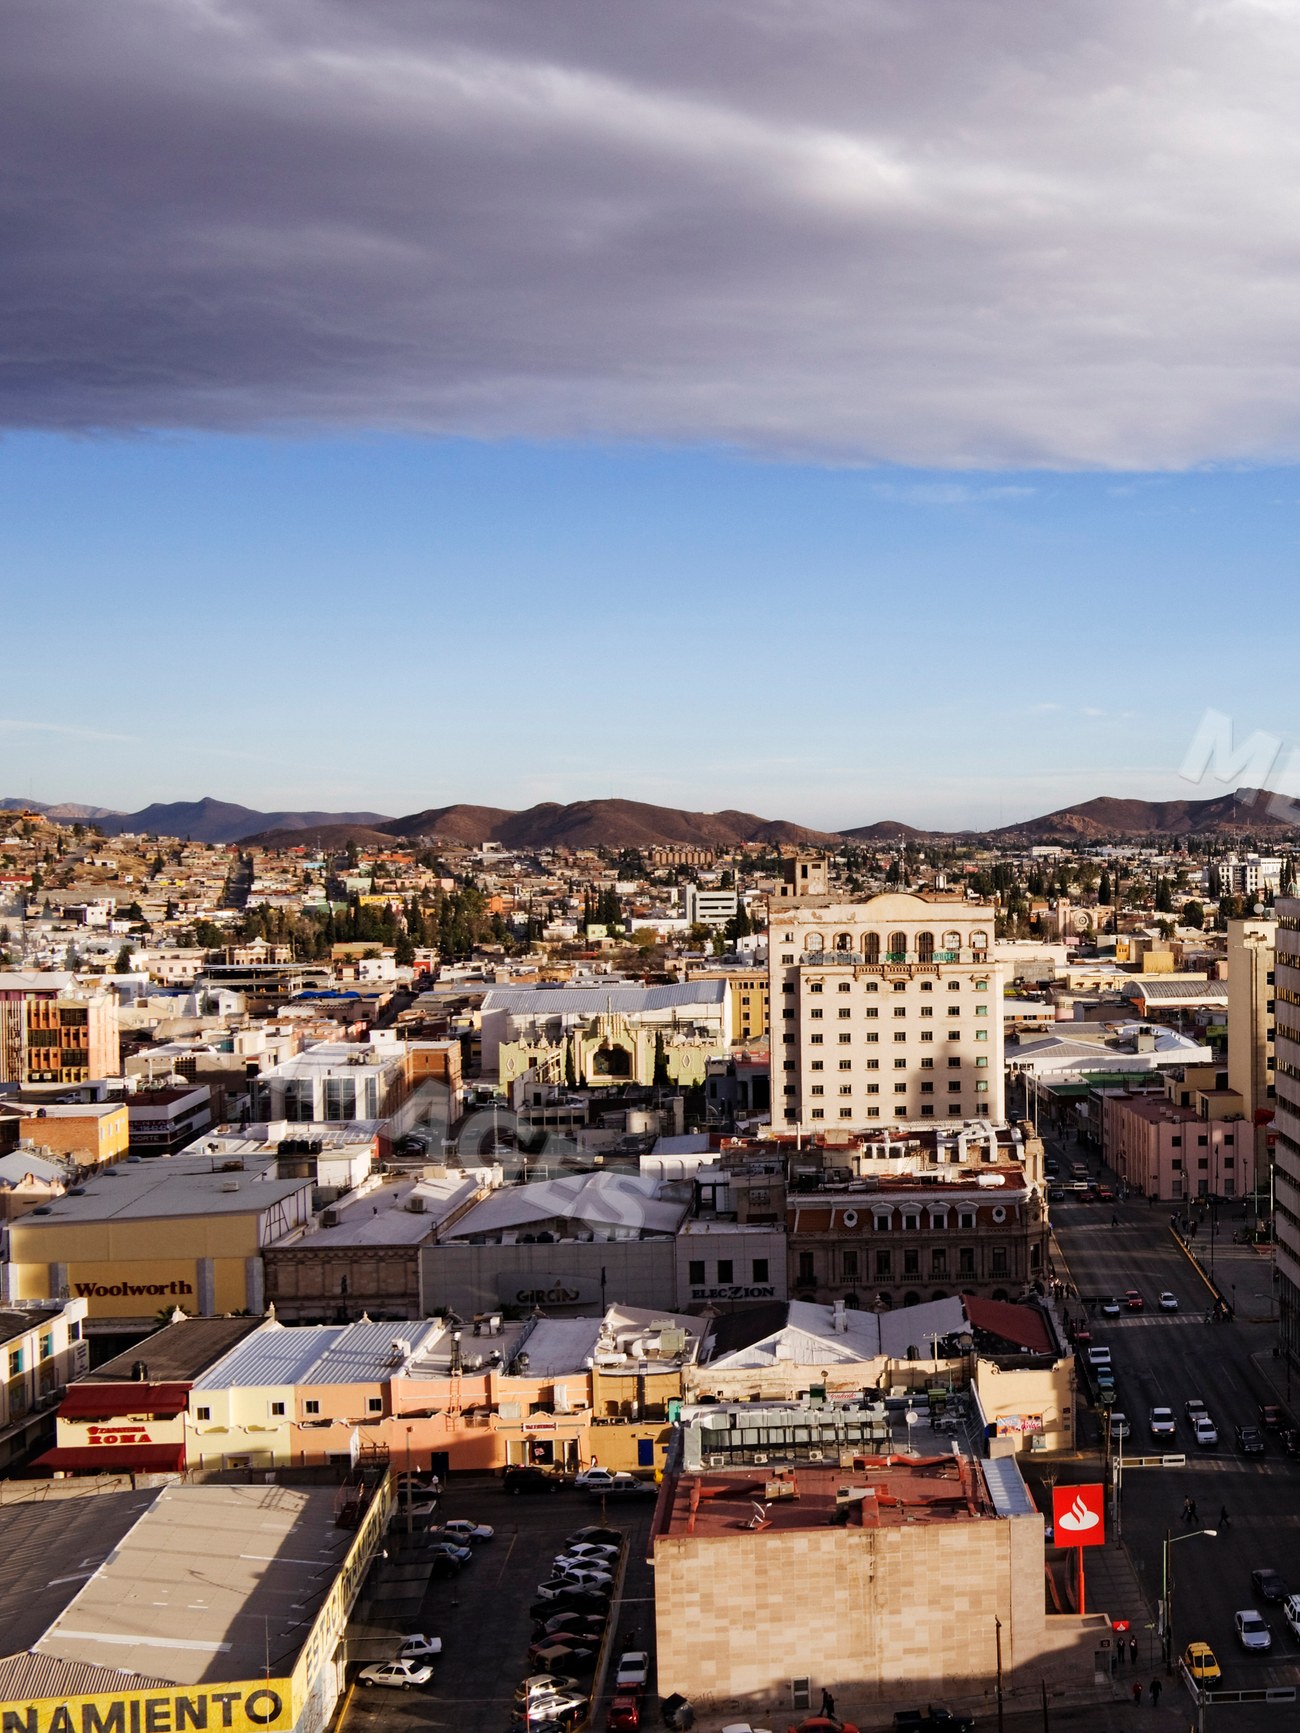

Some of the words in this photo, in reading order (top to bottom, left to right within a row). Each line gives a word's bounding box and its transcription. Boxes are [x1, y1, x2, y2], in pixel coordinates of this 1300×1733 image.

[74, 1280, 193, 1297] Woolworth
[692, 1286, 775, 1299] ELECZION
[88, 1434, 152, 1445] ROMA
[2, 1689, 282, 1733] NAMIENTO
